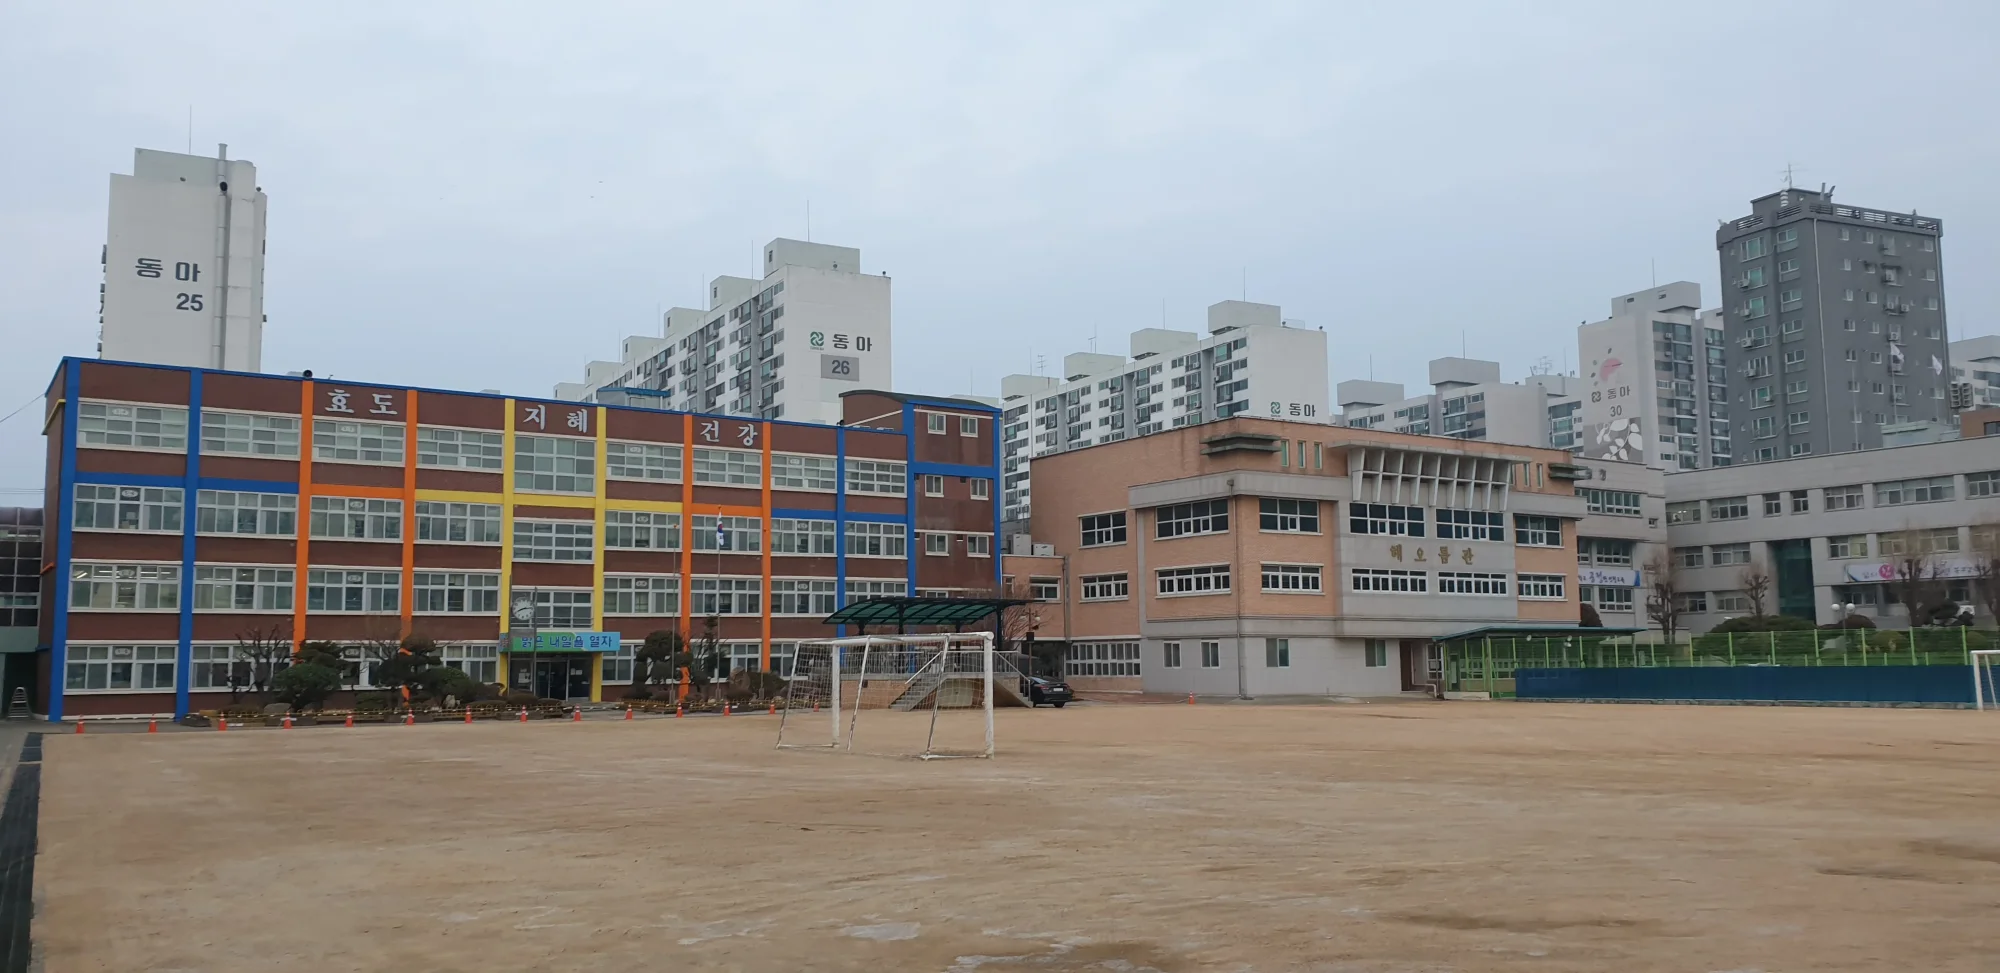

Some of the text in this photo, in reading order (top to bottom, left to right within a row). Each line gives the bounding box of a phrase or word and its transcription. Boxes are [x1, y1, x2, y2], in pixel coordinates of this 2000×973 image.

[135, 257, 202, 282] 동아
[176, 292, 204, 312] 25
[832, 333, 873, 352] 동아
[831, 359, 850, 375] 26
[1607, 385, 1631, 400] 동아
[324, 388, 758, 447] 효도 지혜 건강
[1289, 402, 1316, 418] 동아
[1610, 404, 1622, 417] 30
[589, 635, 612, 648] 열자
